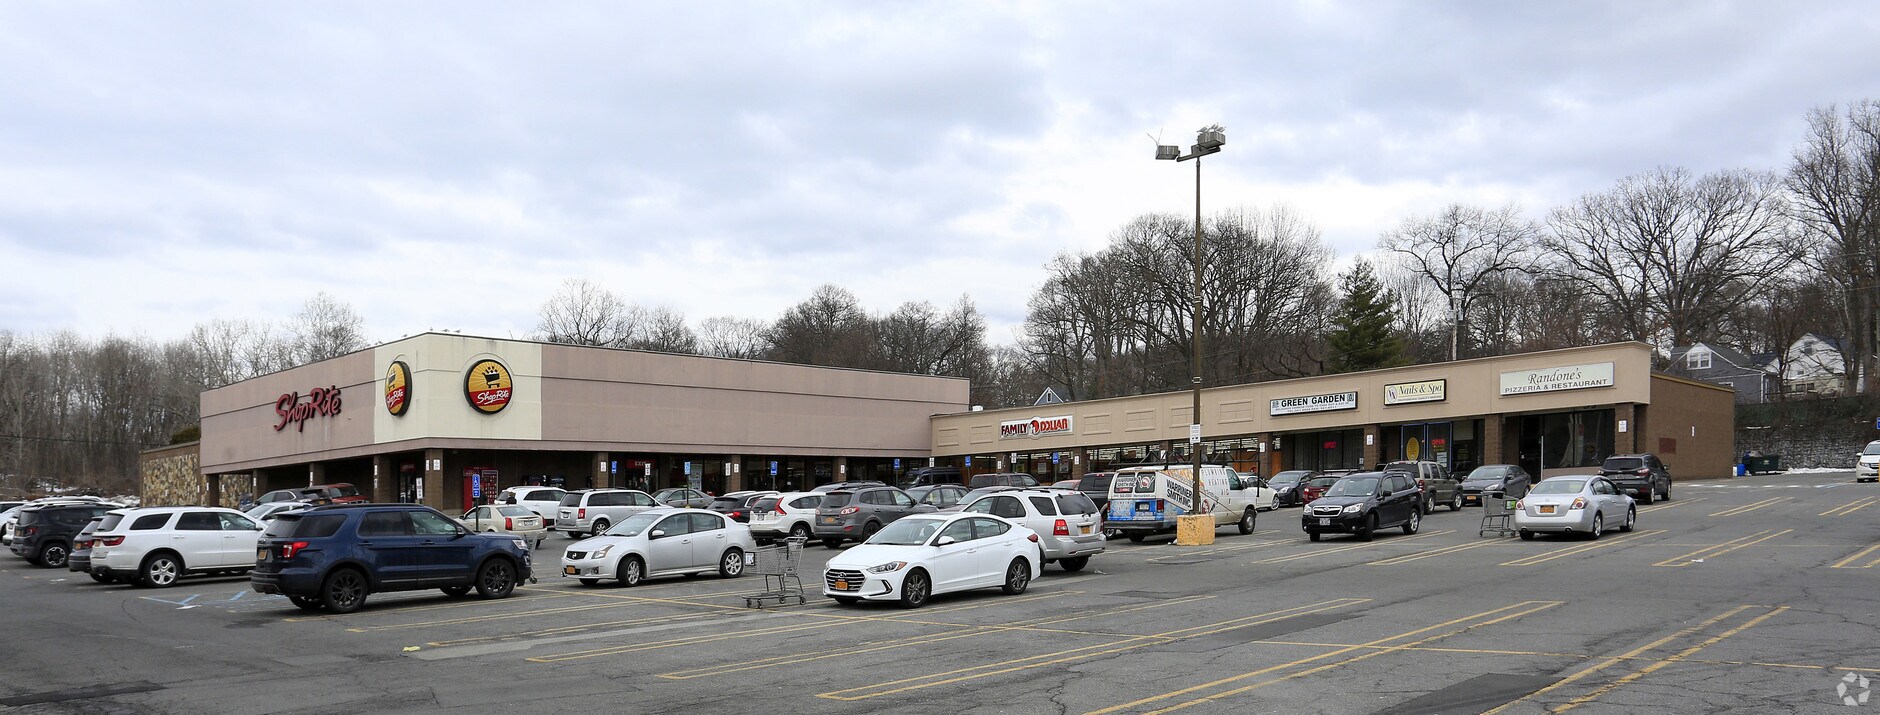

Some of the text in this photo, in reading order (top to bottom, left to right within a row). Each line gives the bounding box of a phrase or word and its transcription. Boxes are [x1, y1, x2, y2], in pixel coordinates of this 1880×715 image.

[1528, 368, 1582, 385] Randone's
[1399, 383, 1442, 395] Nails & Spa
[1504, 385, 1541, 393] PIZZERIA
[1551, 379, 1608, 389] RESTAURANT
[477, 389, 510, 405] ShopRite
[1281, 394, 1346, 407] GREEN GARDEN
[274, 385, 342, 432] ShopRite
[1001, 418, 1068, 436] FAMILY DOLLAR
